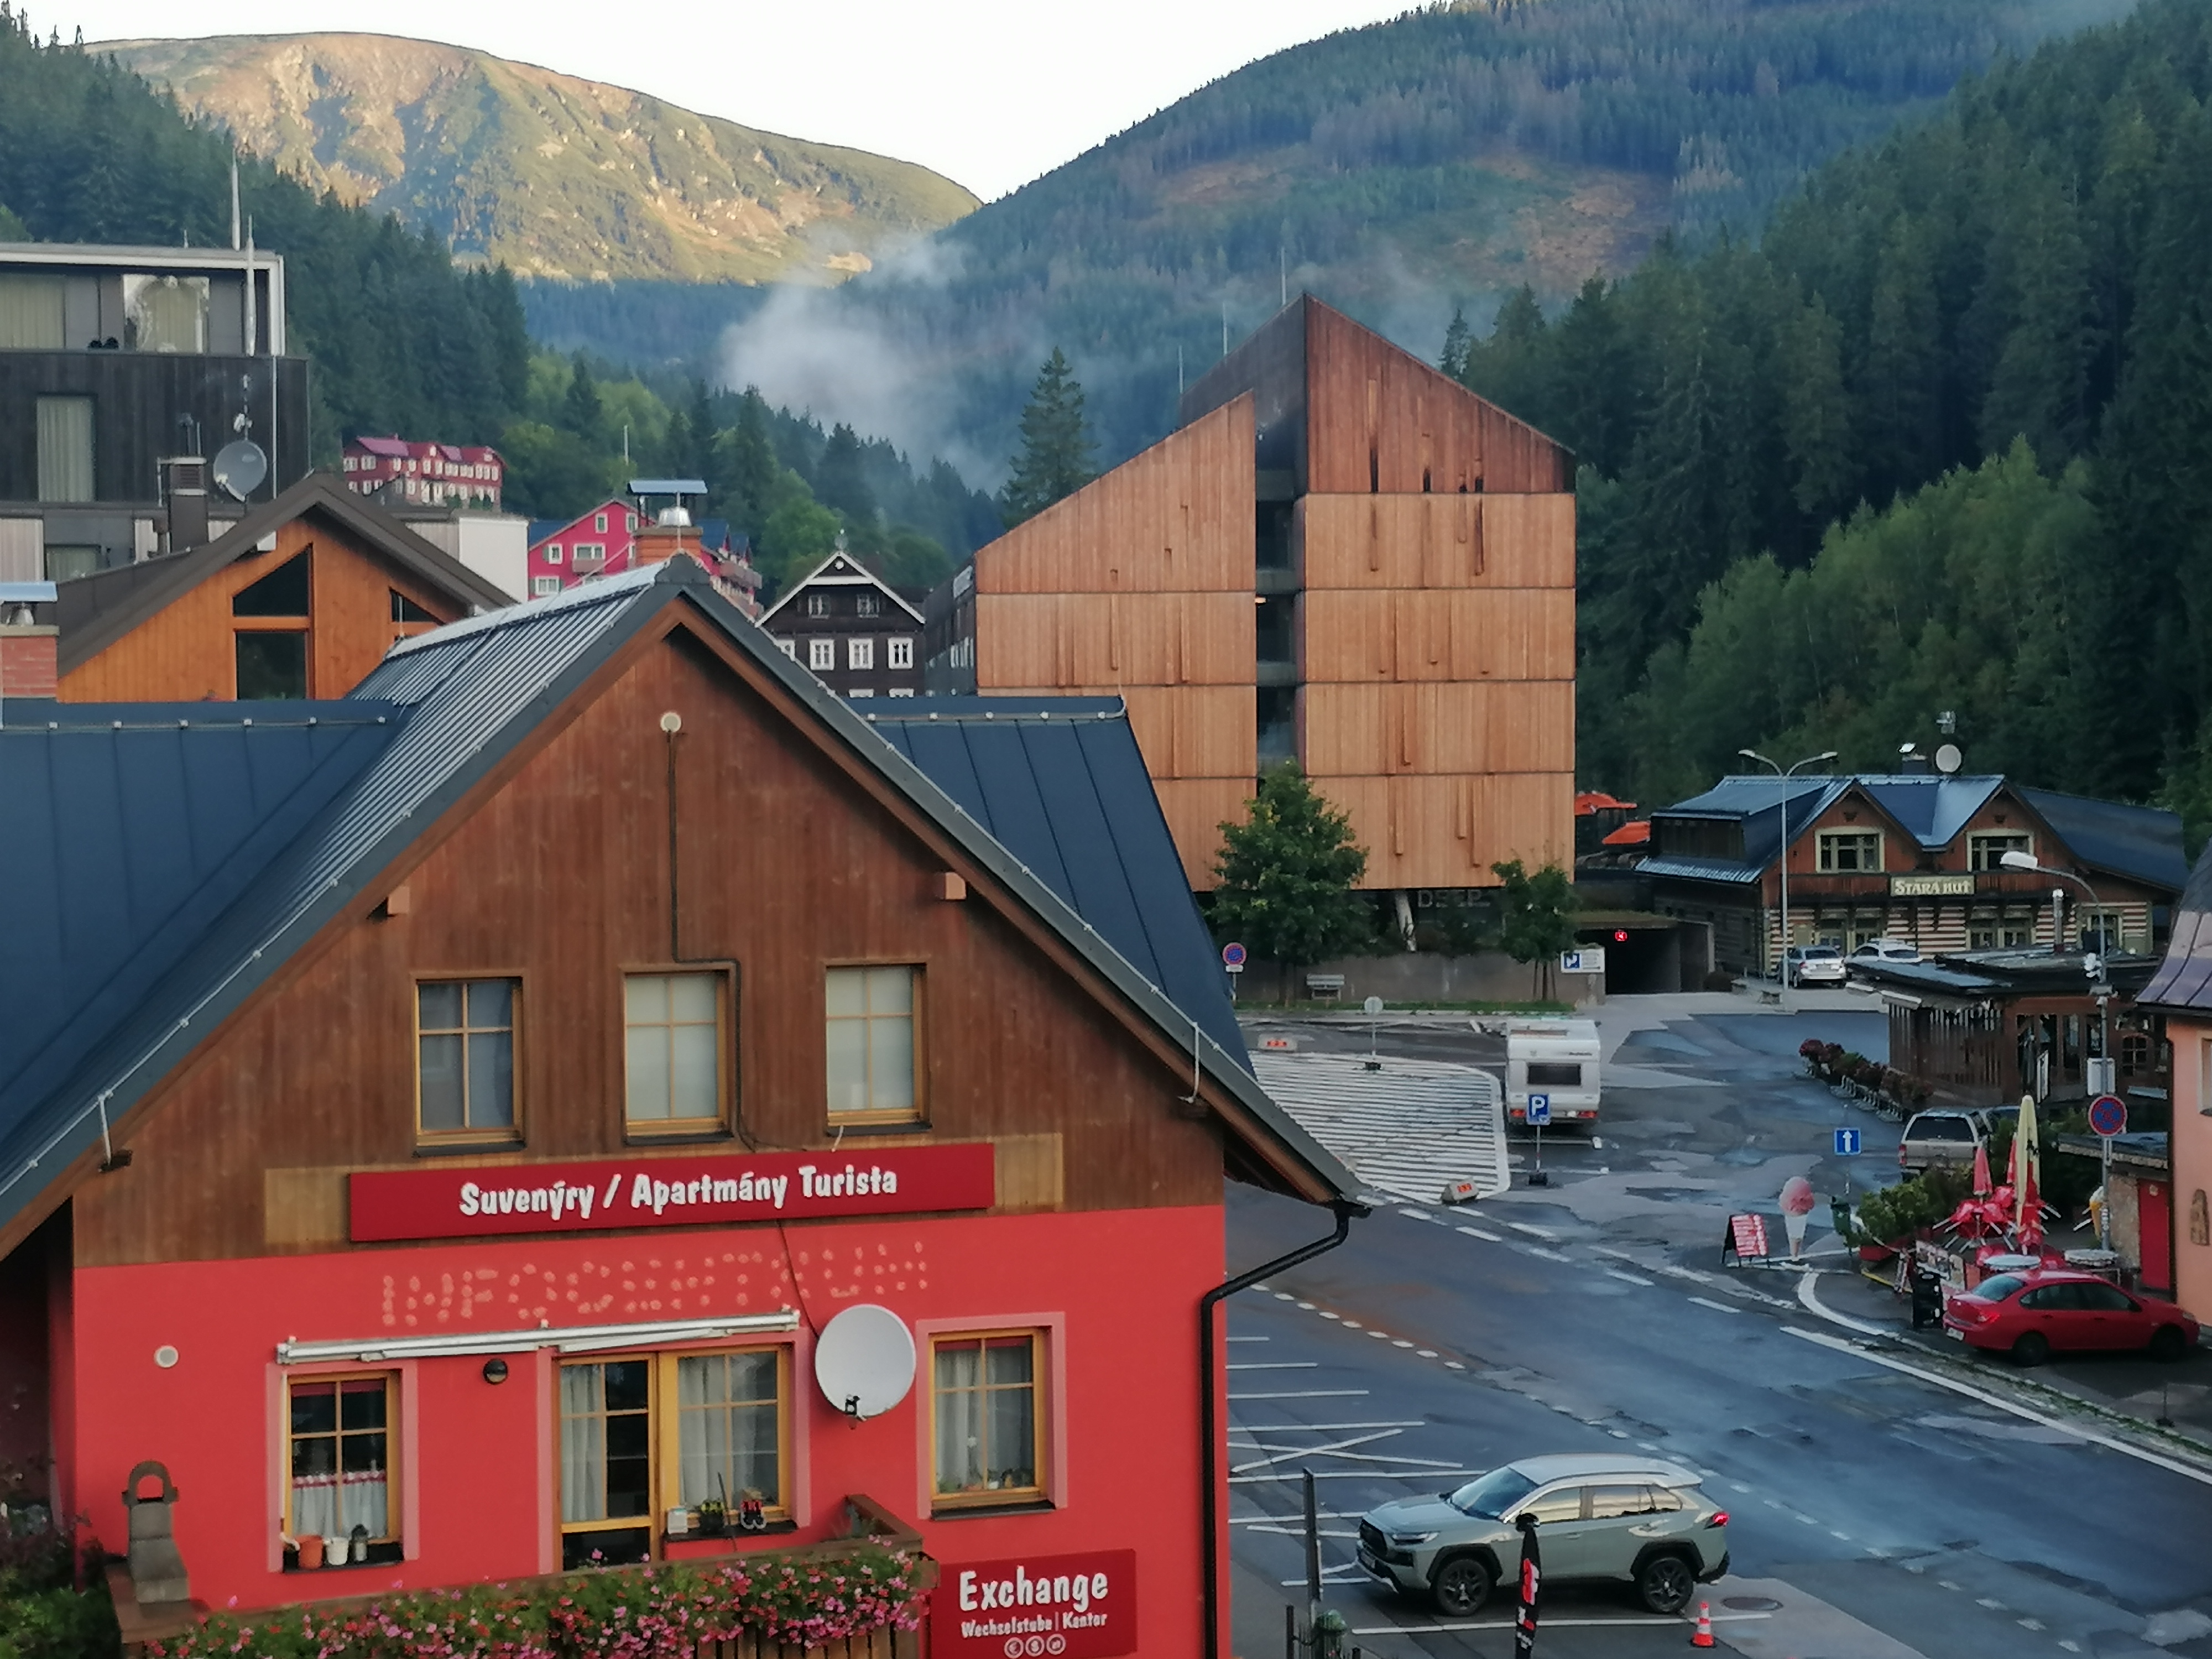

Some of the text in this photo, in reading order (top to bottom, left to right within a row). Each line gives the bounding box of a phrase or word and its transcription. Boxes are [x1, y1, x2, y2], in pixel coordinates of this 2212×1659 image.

[1531, 1096, 1546, 1116] P
[459, 1164, 898, 1221] Suvenýry / Apartmány Turista
[959, 1565, 1108, 1613] Exchange
[961, 1614, 1053, 1638] Wechselstube
